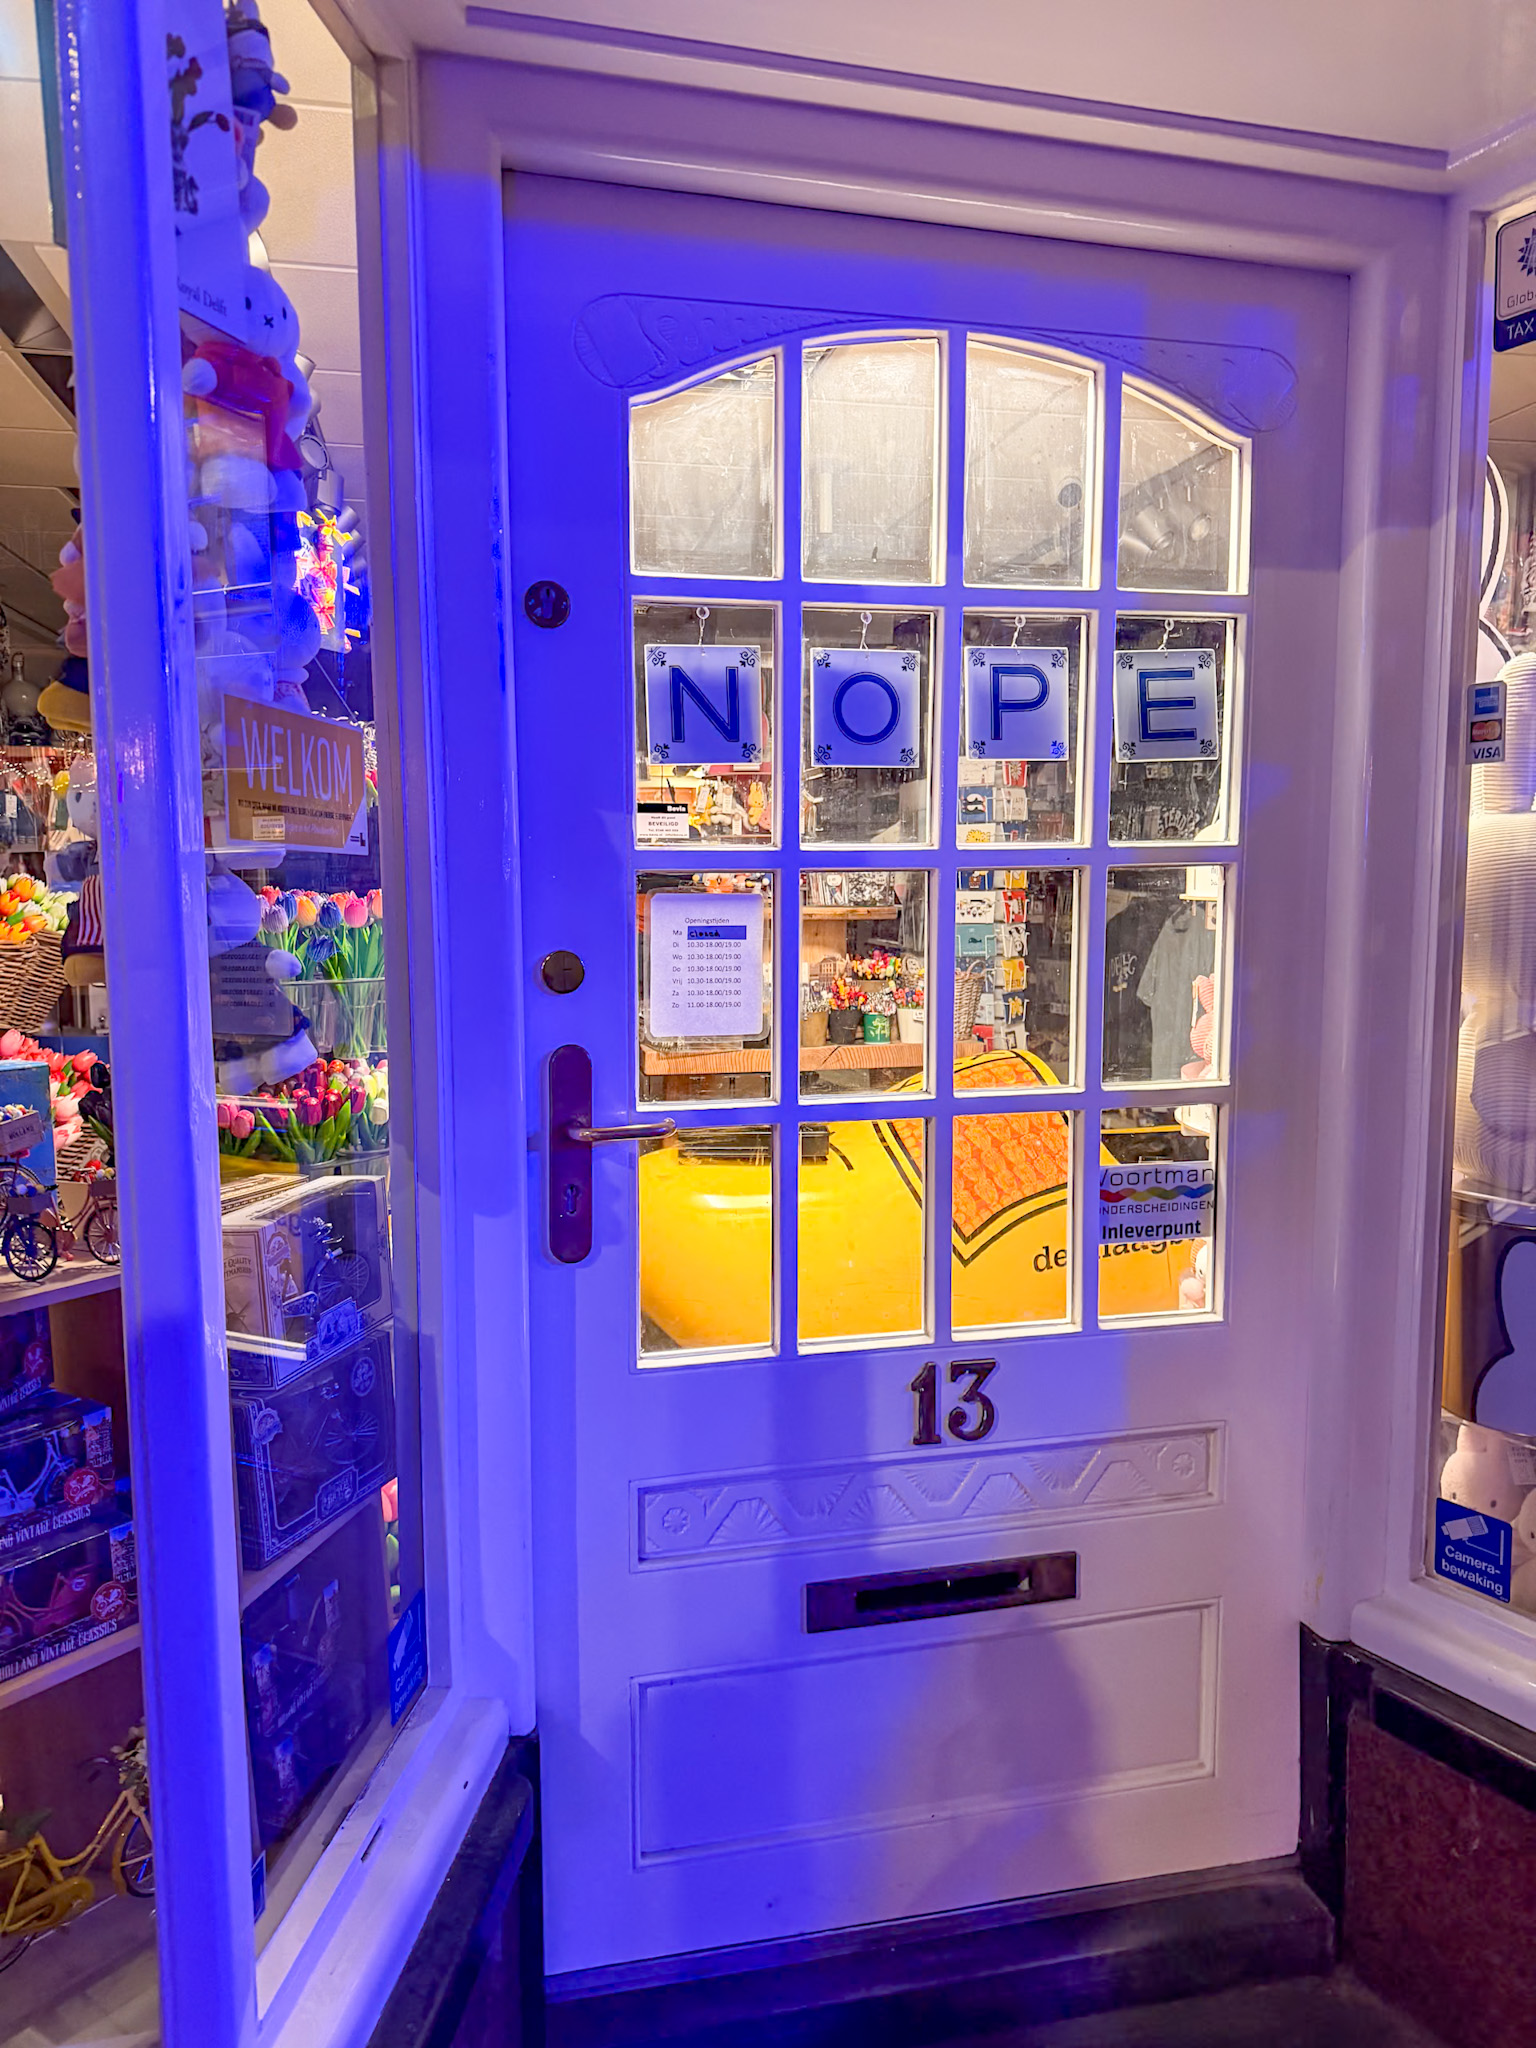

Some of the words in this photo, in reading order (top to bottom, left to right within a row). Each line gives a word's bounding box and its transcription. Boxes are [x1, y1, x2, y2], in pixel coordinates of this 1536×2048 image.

[177, 276, 201, 303] oyal
[1507, 289, 1536, 308] Glob
[1507, 317, 1535, 340] TAX
[240, 716, 353, 805] WELKOM
[1473, 746, 1501, 759] VISA
[689, 929, 721, 938] closed
[1099, 1200, 1215, 1216] NDERSCHEIDINGEN
[1102, 1219, 1202, 1241] Inleverpunt
[911, 1358, 997, 1445] 13
[15, 1519, 51, 1544] VINTAGE
[52, 1503, 92, 1530] CLASSICS
[1445, 1545, 1502, 1575] Camera-
[1441, 1558, 1504, 1596] bewaking
[40, 1635, 76, 1663] VINTAGE
[78, 1618, 118, 1646] CLASSICS
